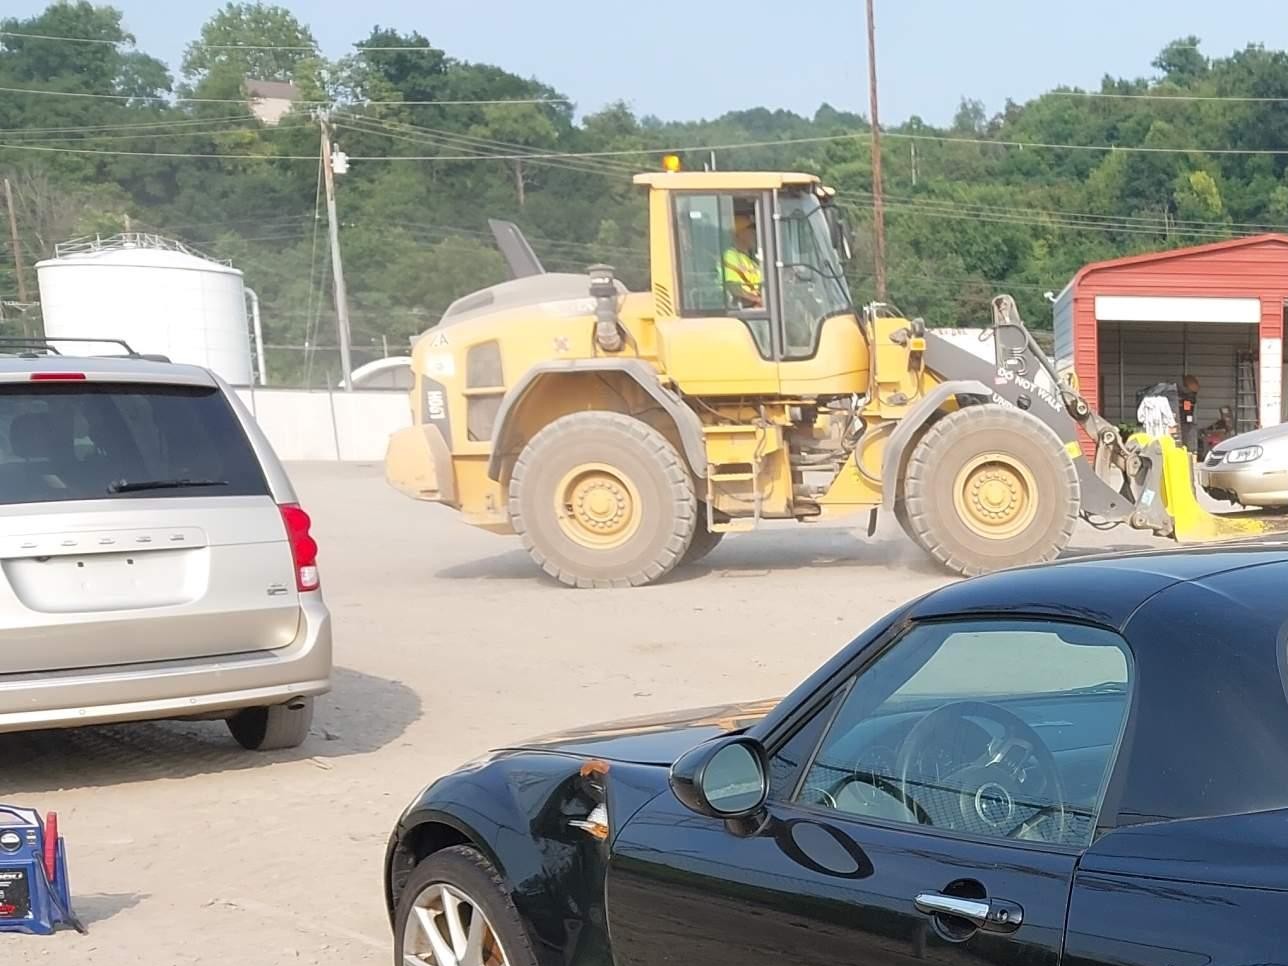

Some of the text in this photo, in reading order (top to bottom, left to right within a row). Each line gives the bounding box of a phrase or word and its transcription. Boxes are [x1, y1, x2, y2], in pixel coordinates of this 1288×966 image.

[997, 367, 1063, 413] DO NOT WALK
